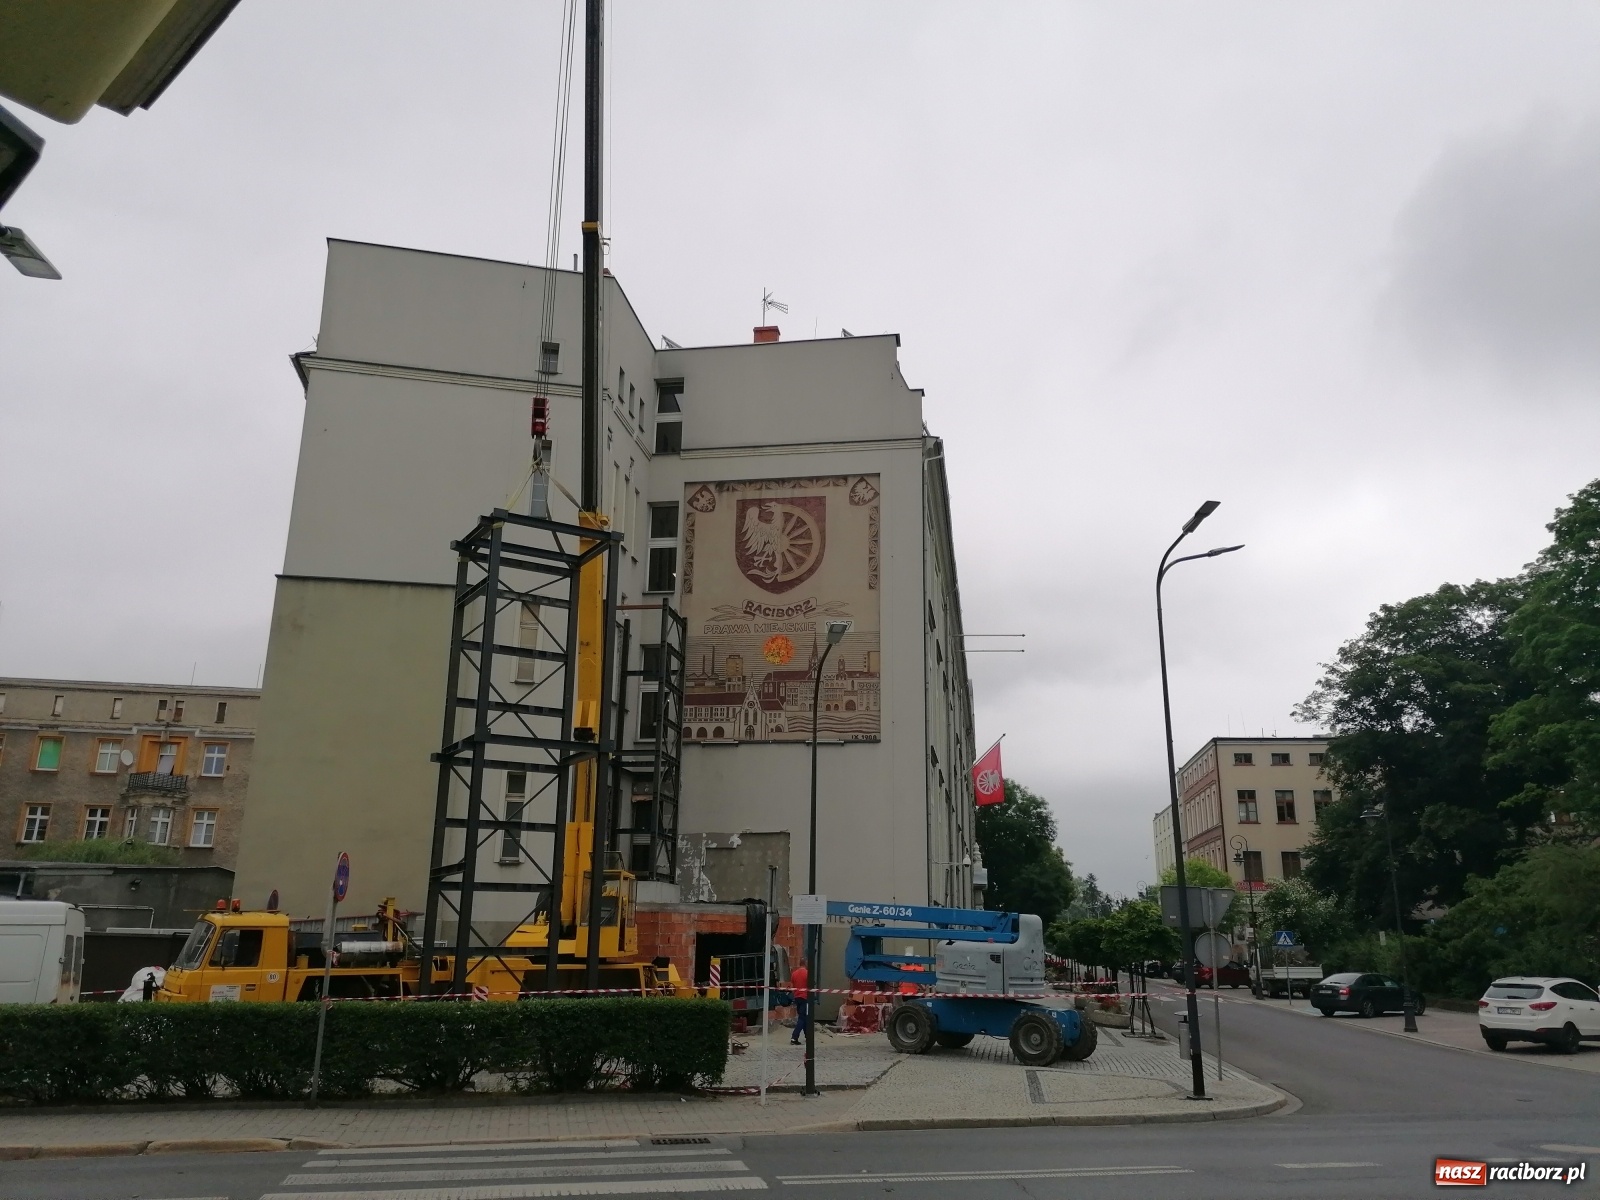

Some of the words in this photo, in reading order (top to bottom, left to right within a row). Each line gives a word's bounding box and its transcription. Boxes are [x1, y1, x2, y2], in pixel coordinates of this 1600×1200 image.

[704, 624, 750, 635] PRAWA
[754, 622, 817, 634] MIEJSKIE
[825, 621, 852, 633] 17
[848, 904, 871, 915] Genie
[872, 905, 913, 917] Z-60/34
[952, 961, 976, 971] Genie
